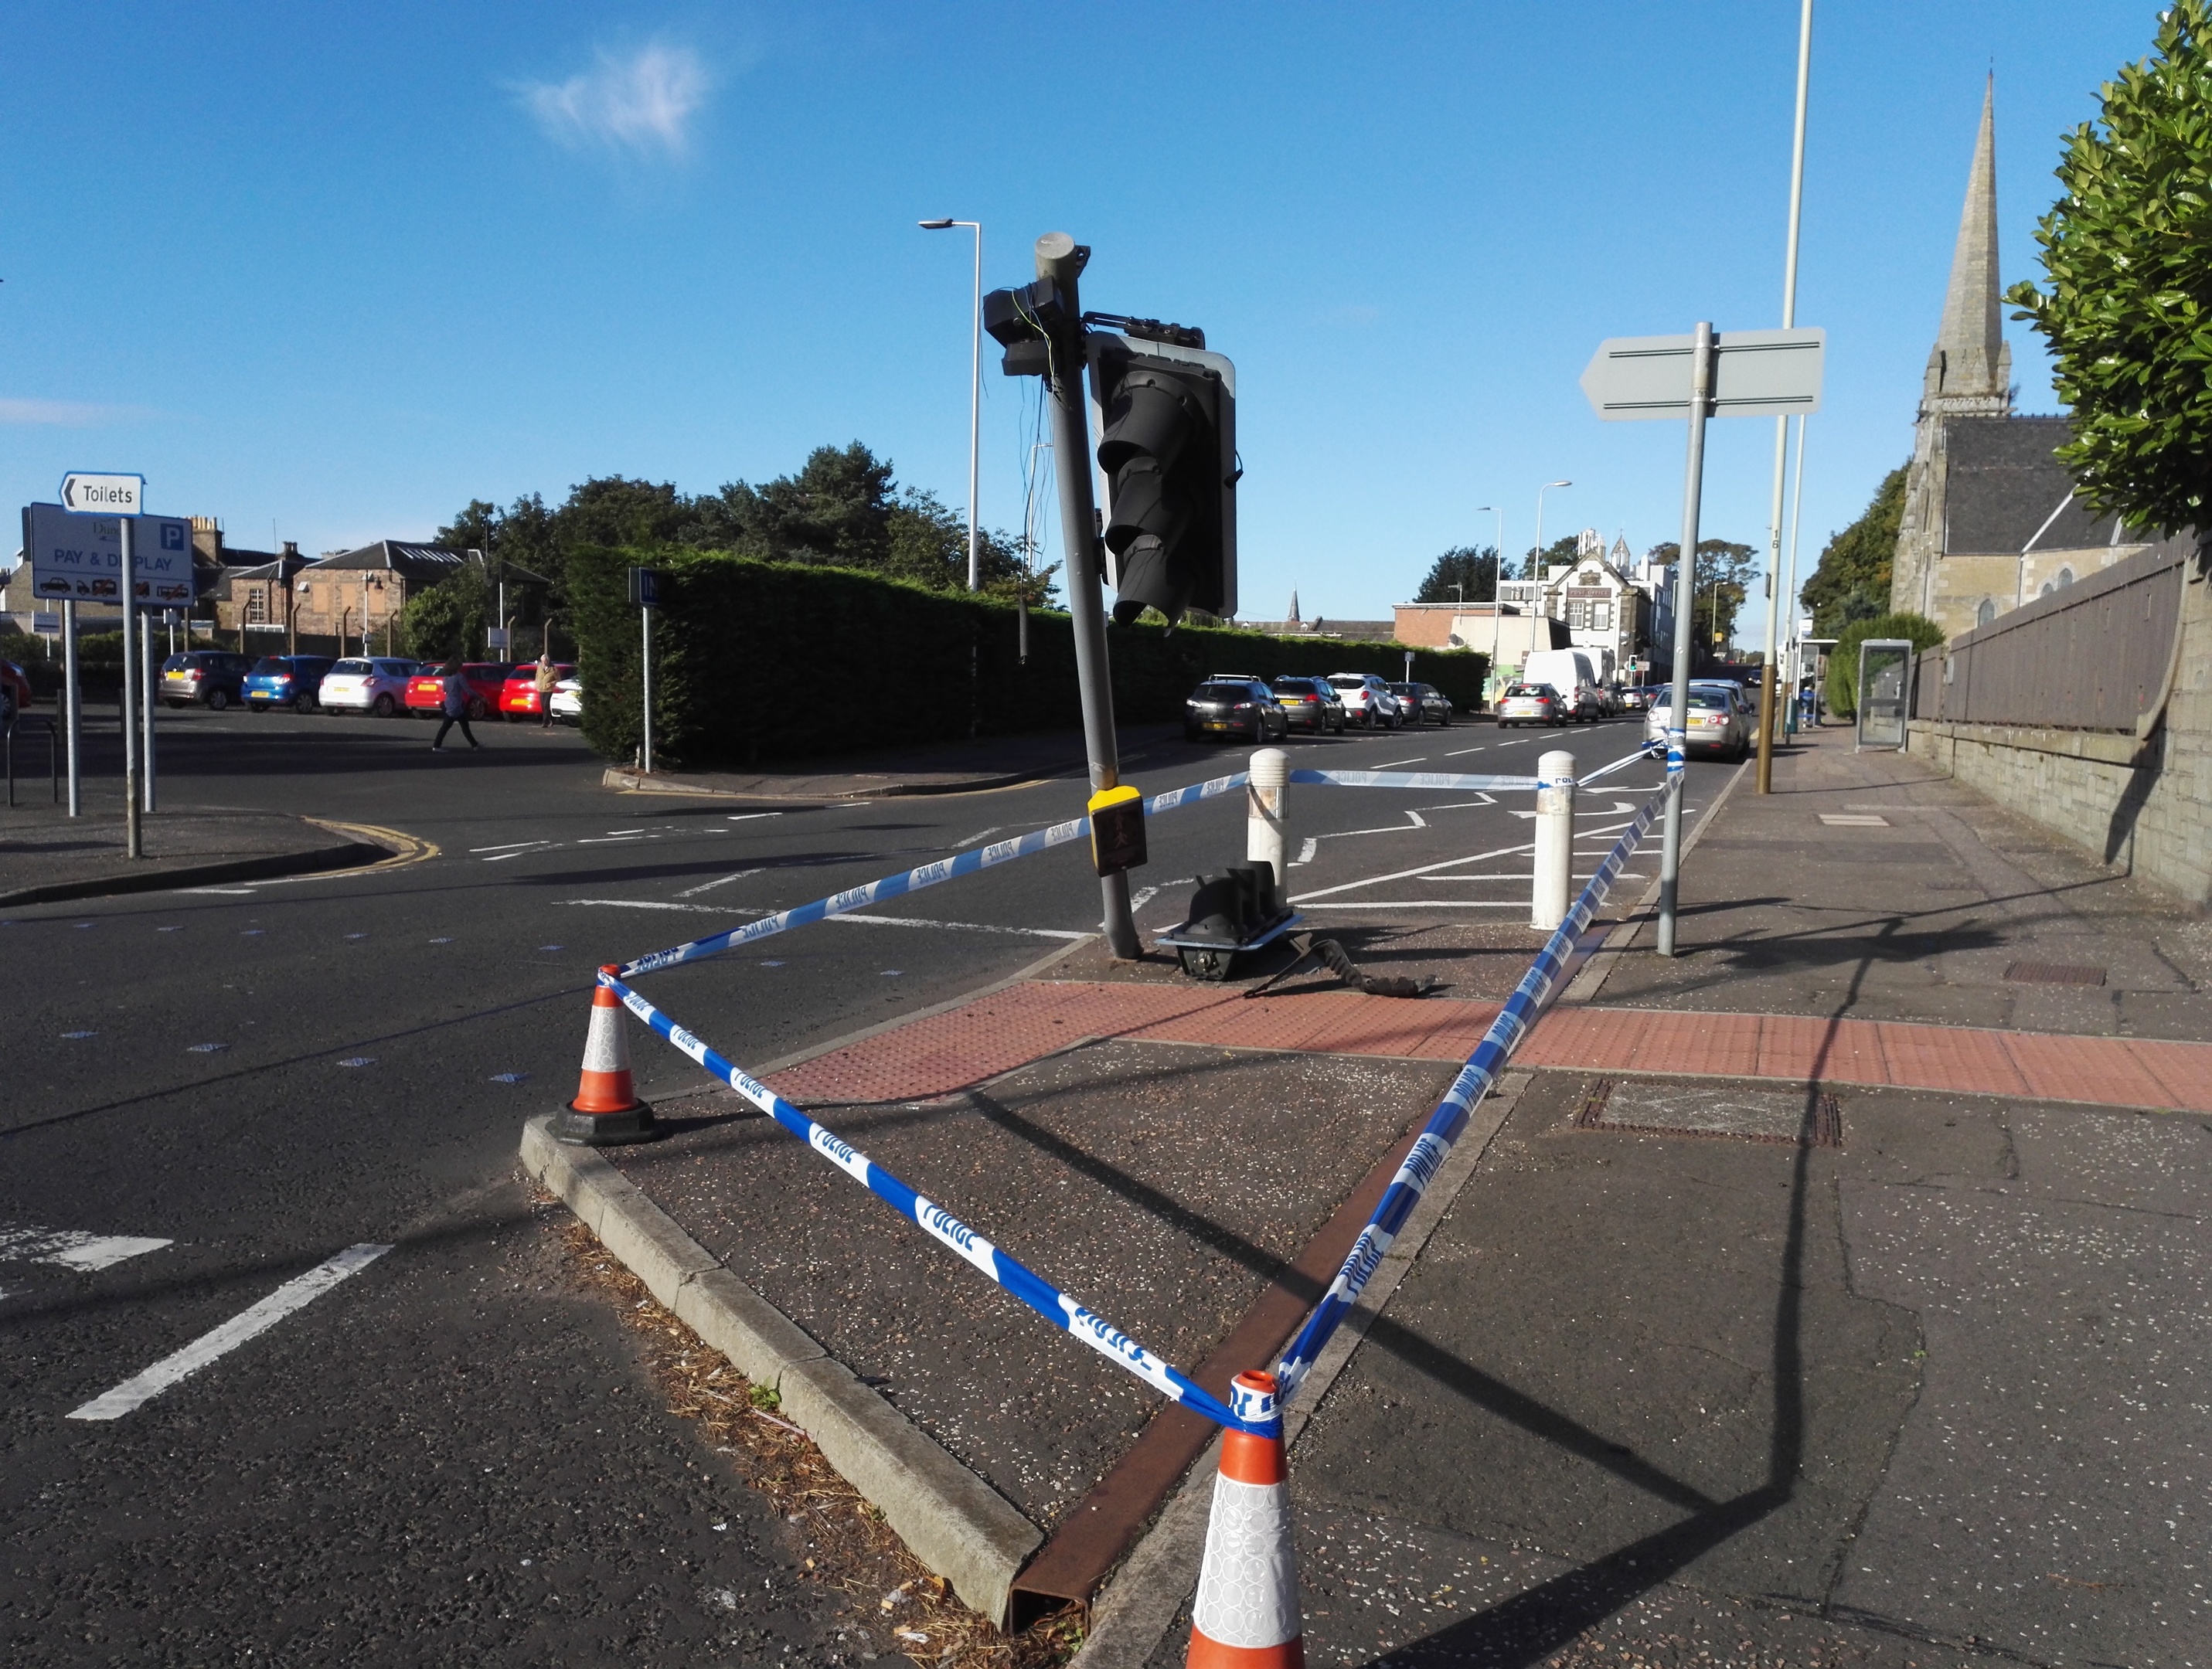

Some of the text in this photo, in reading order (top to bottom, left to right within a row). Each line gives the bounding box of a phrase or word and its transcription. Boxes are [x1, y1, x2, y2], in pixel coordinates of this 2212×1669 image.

[83, 485, 132, 503] Toilets
[165, 526, 180, 547] P
[54, 549, 172, 571] PAY & DIPLAY
[1453, 1069, 1486, 1110] POLICE
[1403, 1138, 1443, 1191] POLICE
